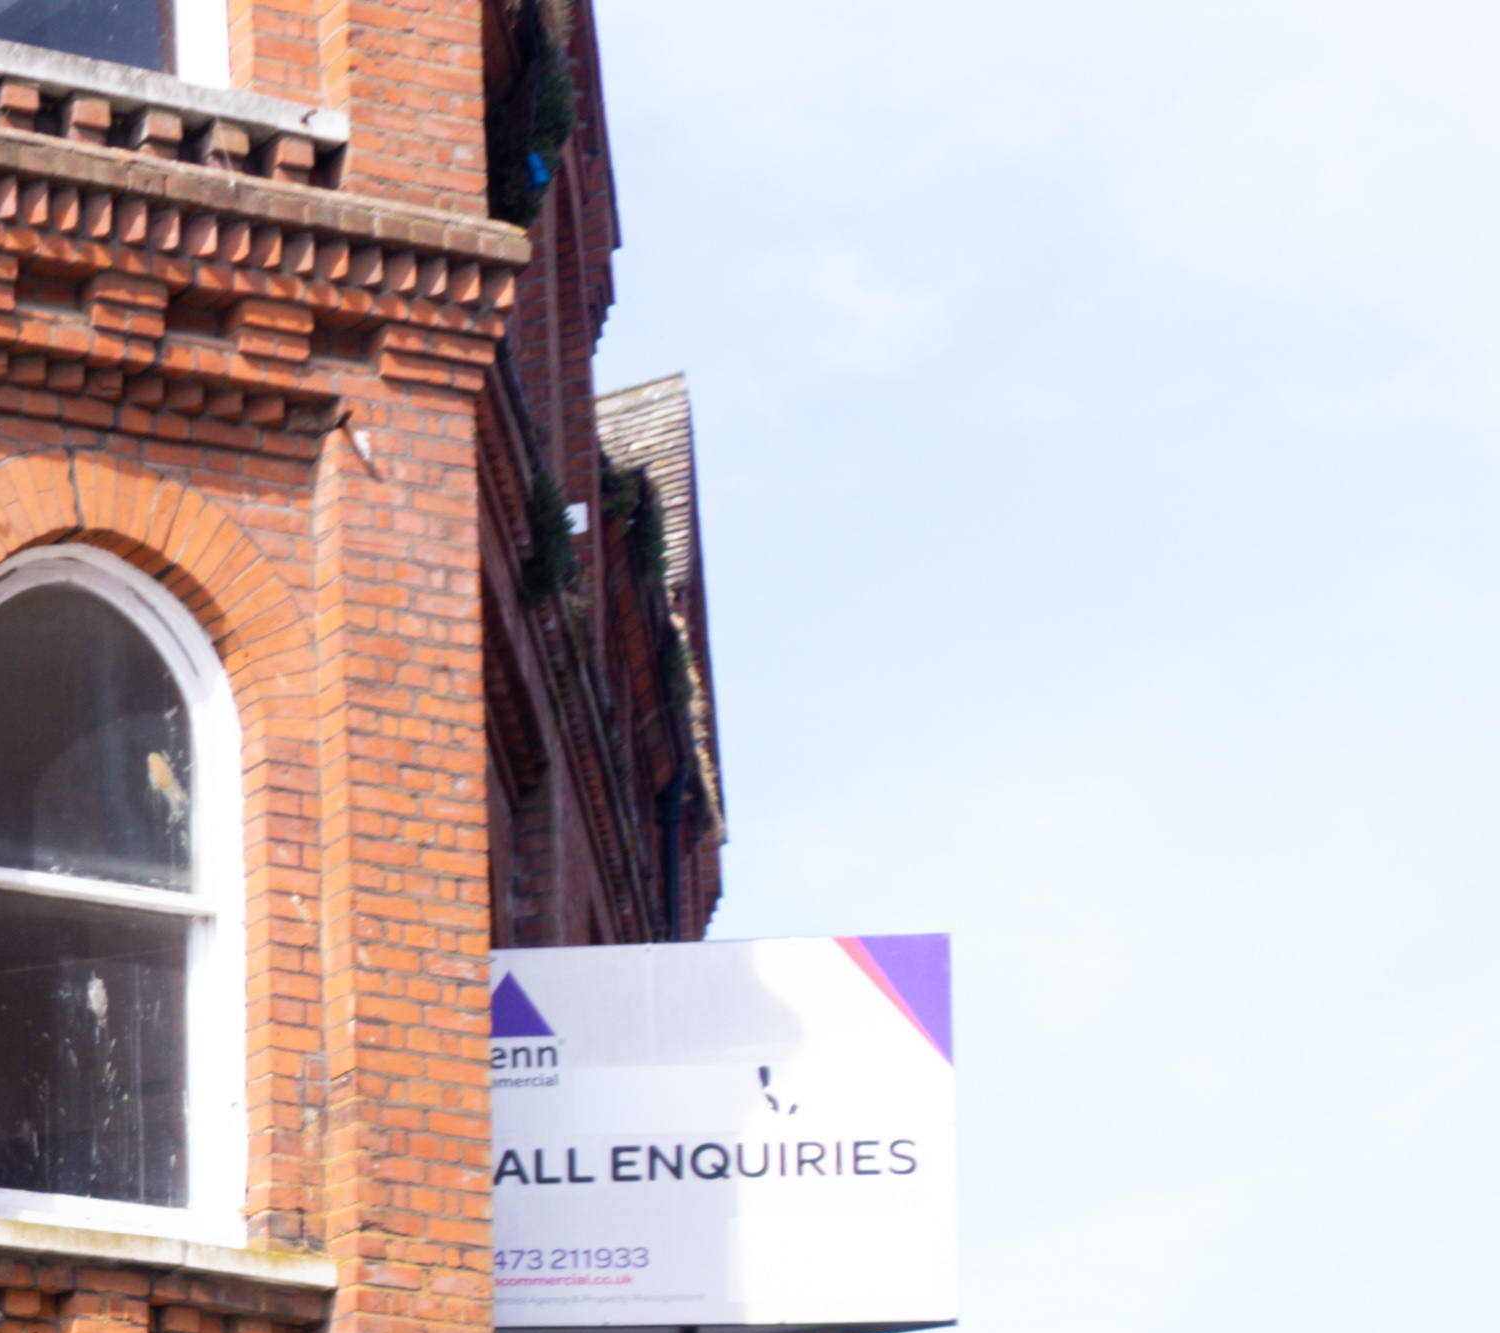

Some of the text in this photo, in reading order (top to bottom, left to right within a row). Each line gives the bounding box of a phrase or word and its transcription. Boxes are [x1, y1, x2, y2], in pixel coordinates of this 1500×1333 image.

[493, 1139, 918, 1186] ALL ENQUIRIES
[550, 1246, 650, 1269] 211933
